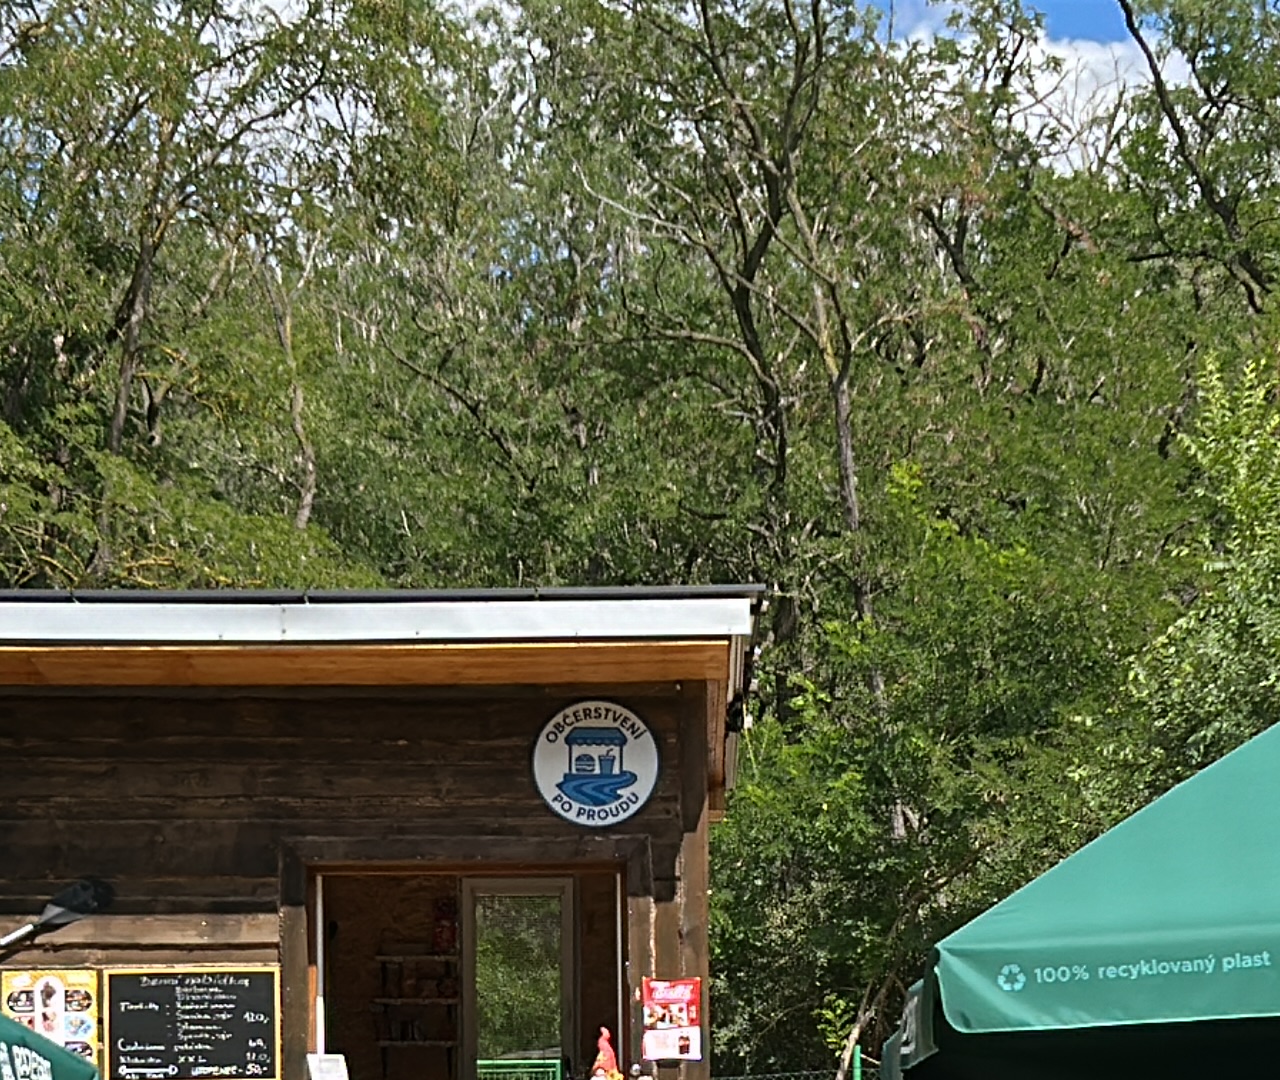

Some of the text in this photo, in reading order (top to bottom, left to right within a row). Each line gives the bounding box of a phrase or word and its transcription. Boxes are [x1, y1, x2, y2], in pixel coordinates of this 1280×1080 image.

[546, 707, 647, 743] OBČERSTVENÍ
[552, 792, 639, 821] PO PROUDU
[1033, 951, 1272, 985] 100% recyklovaný plast
